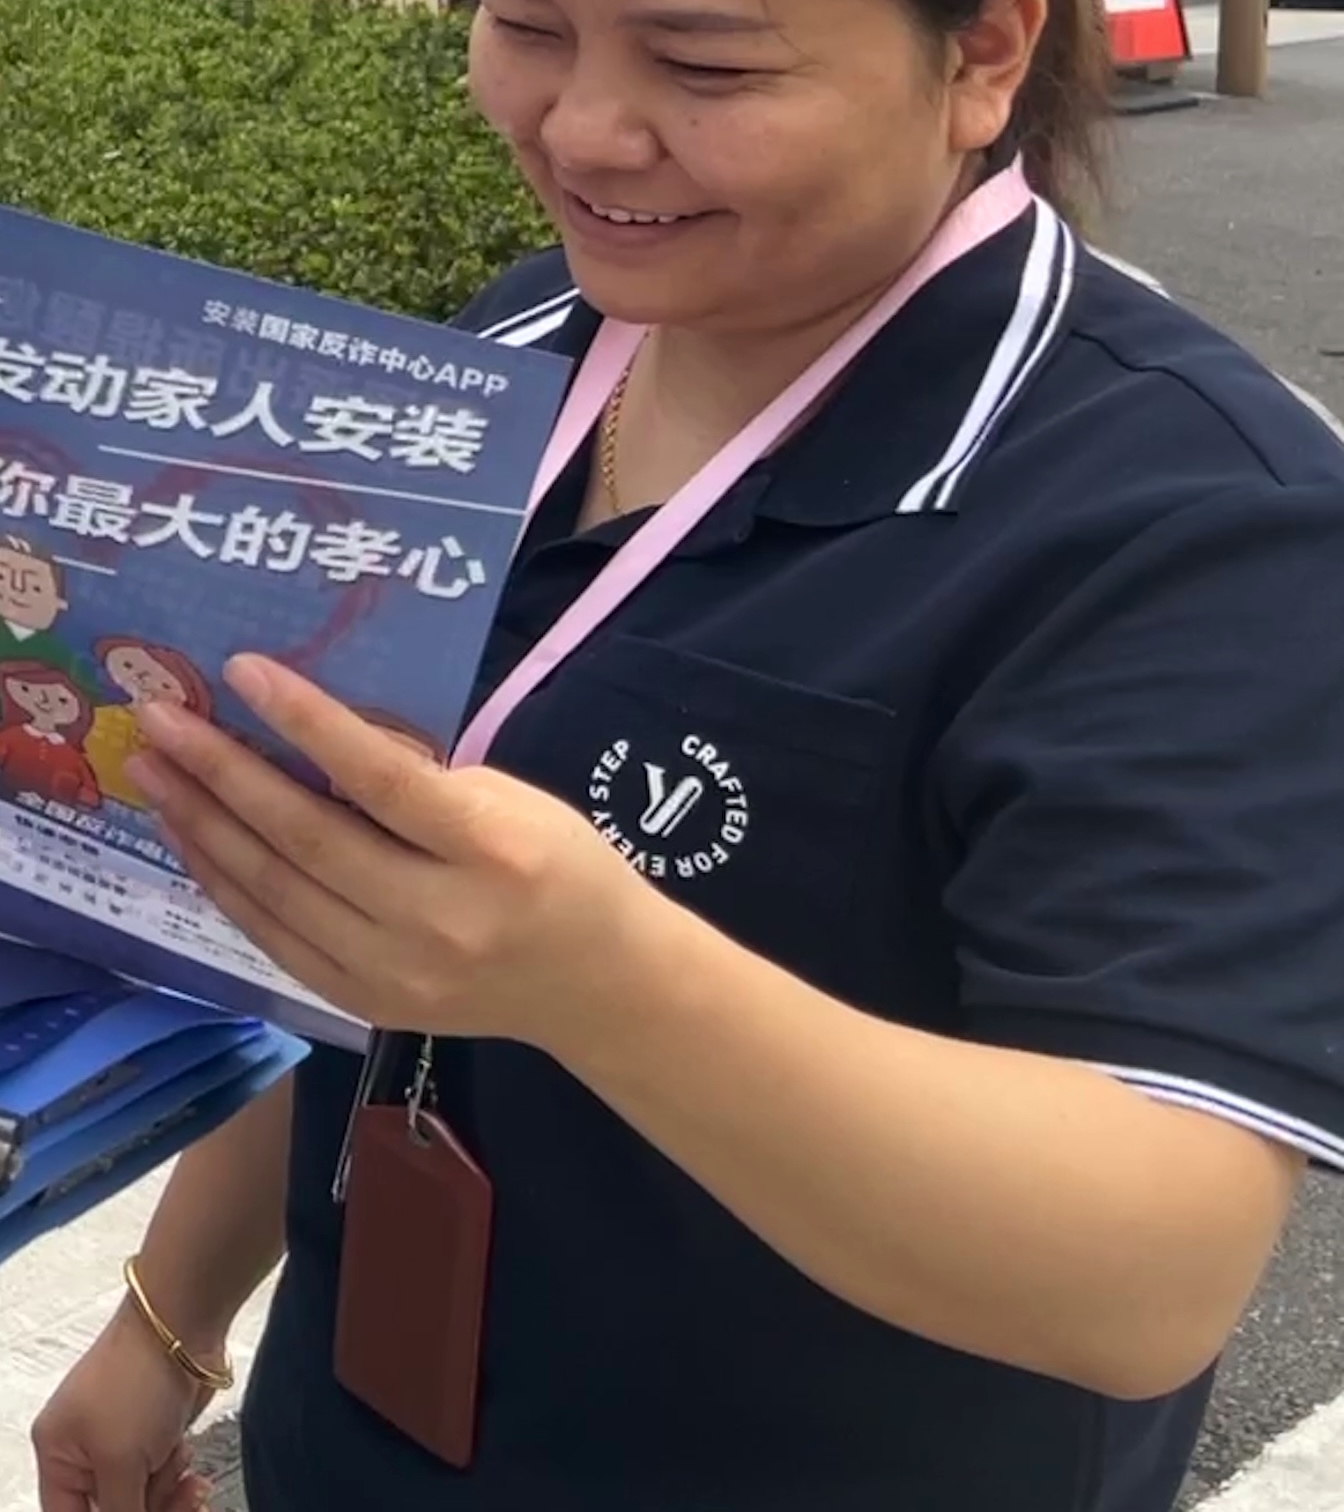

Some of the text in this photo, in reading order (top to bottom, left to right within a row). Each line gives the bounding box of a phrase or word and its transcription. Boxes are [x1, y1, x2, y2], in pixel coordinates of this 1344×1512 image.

[201, 299, 510, 399] 安装国家反诈中心APP
[588, 734, 749, 878] CRAFTED FOR EVERY STEP
